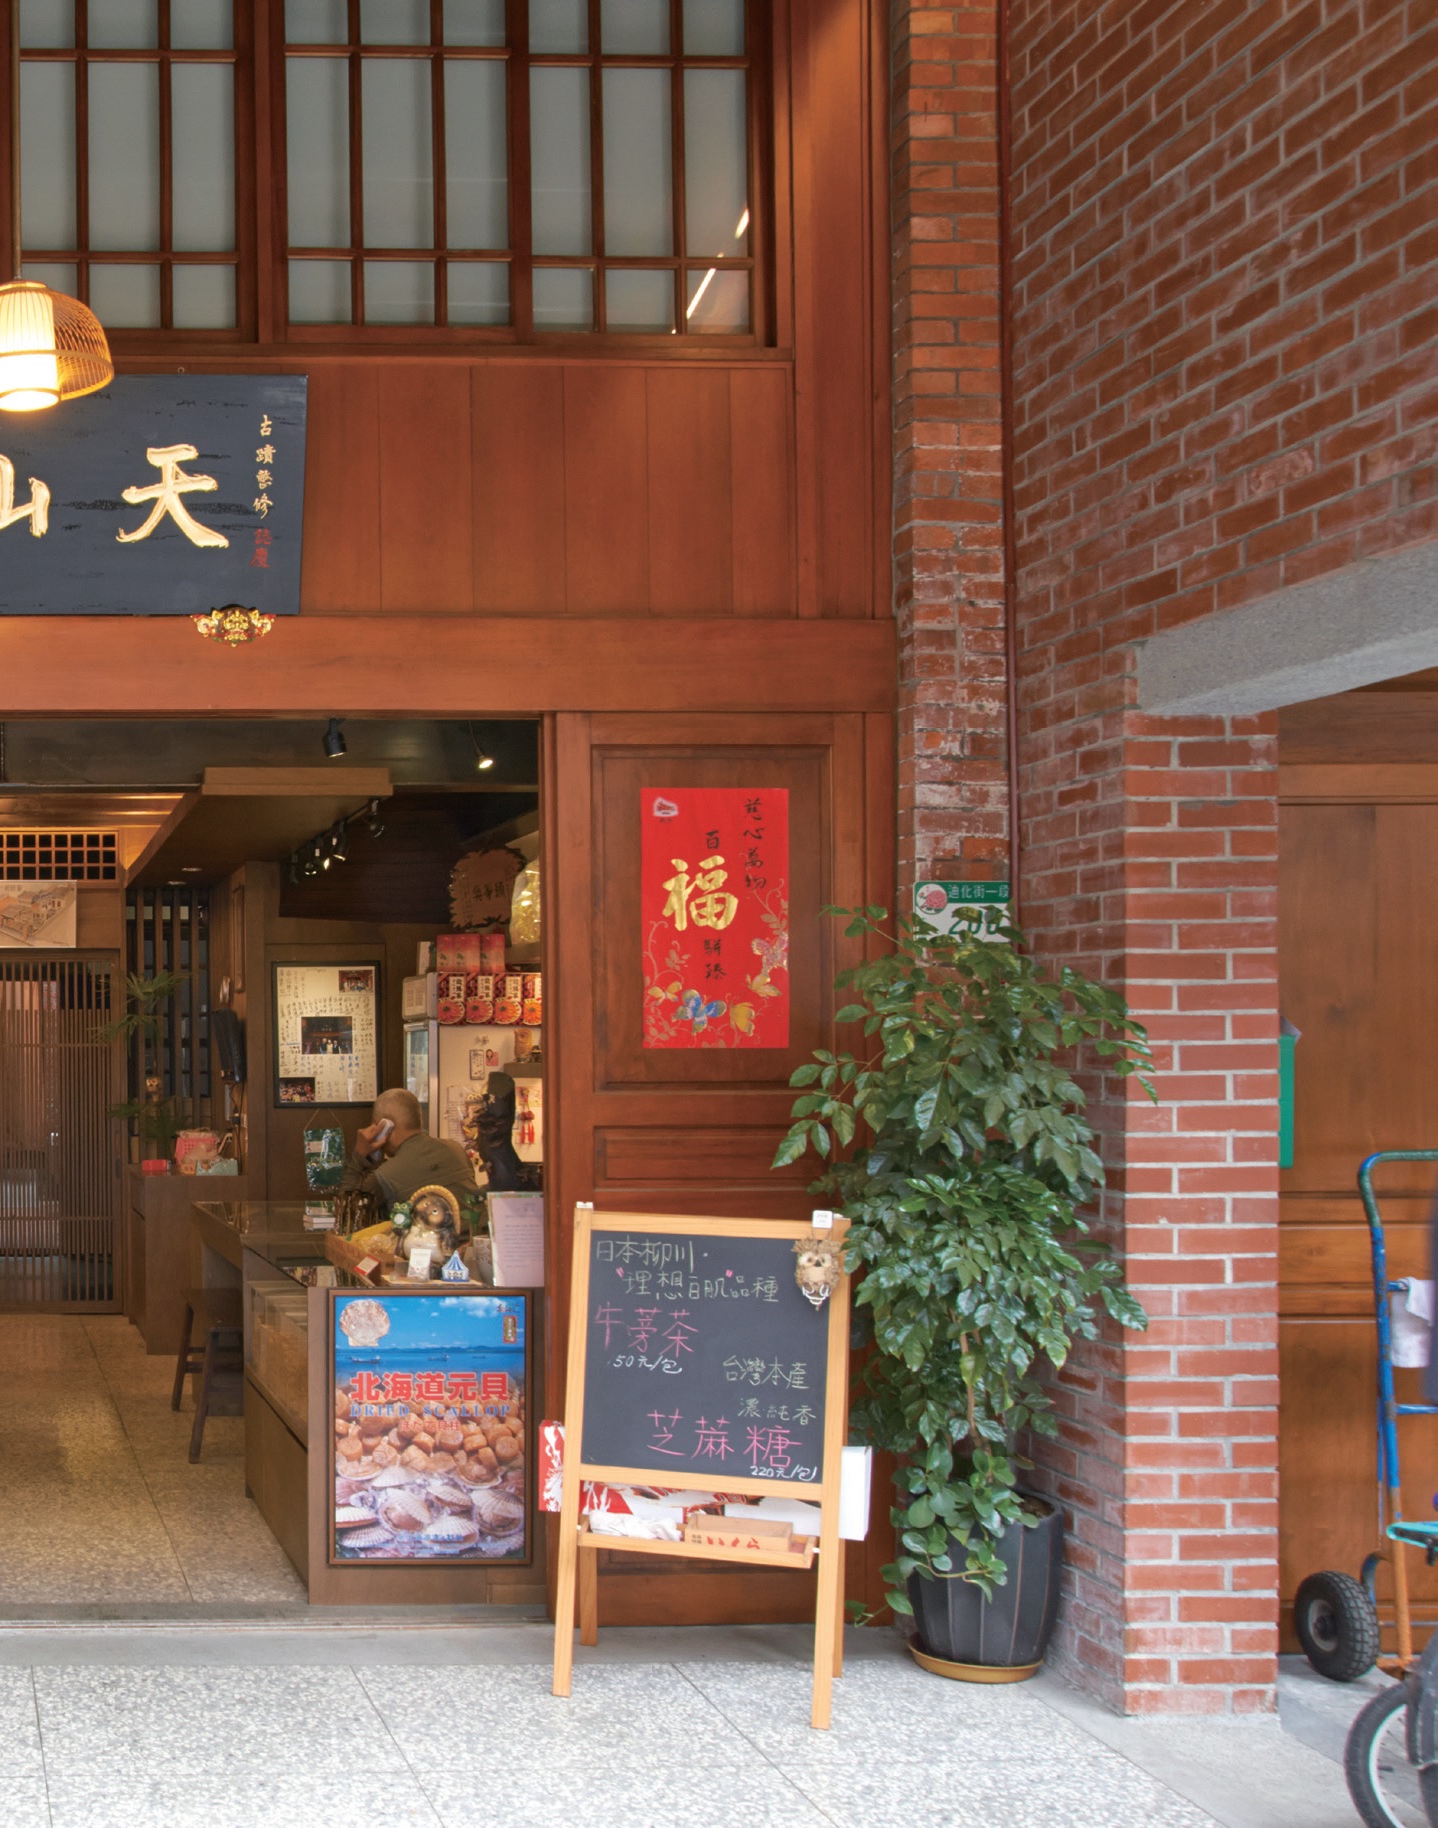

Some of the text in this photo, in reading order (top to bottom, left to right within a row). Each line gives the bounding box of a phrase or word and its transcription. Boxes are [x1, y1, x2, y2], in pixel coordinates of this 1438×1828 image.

[742, 798, 767, 889] 慈心萬物
[948, 884, 1009, 899] 迪化街一段
[594, 1301, 699, 1358] 牛蒡茶
[350, 1371, 509, 1401] 北海道元貝
[722, 1355, 810, 1389] 台灣本產
[350, 1404, 511, 1417] DRIED SCALLOP
